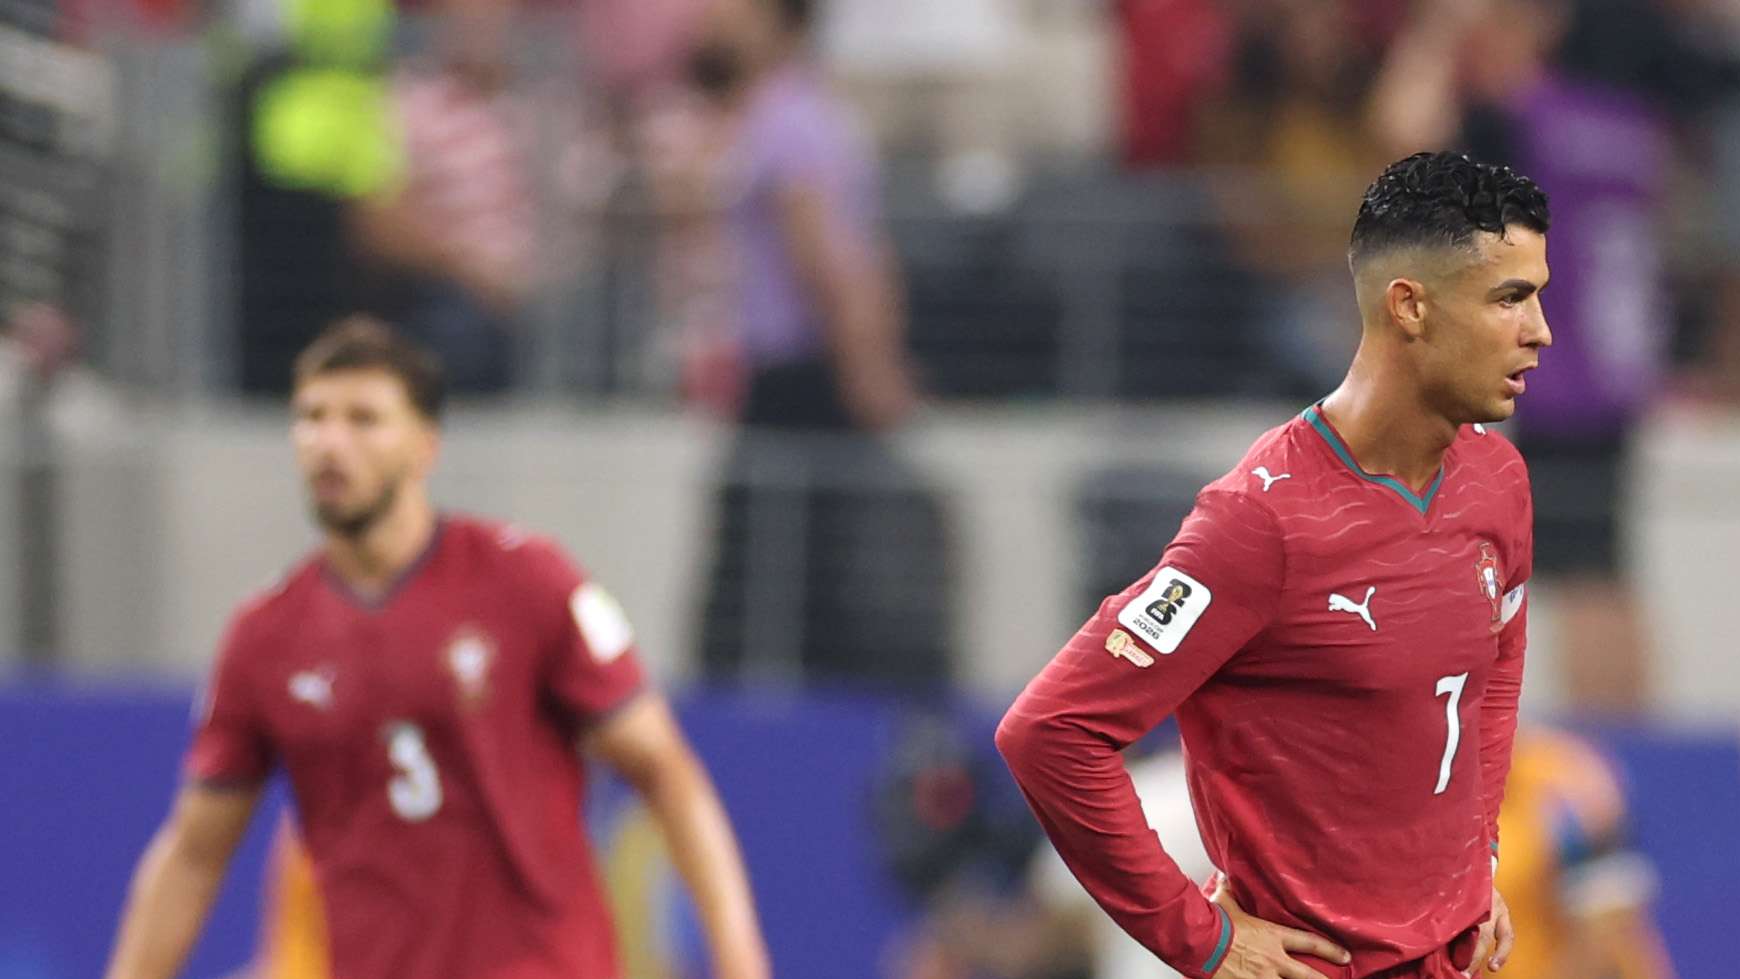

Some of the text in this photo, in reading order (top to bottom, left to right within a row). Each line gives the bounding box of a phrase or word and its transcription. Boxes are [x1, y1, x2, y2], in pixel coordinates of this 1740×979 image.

[1132, 617, 1160, 641] 2026
[384, 718, 444, 822] 3
[1434, 671, 1468, 794] 7
